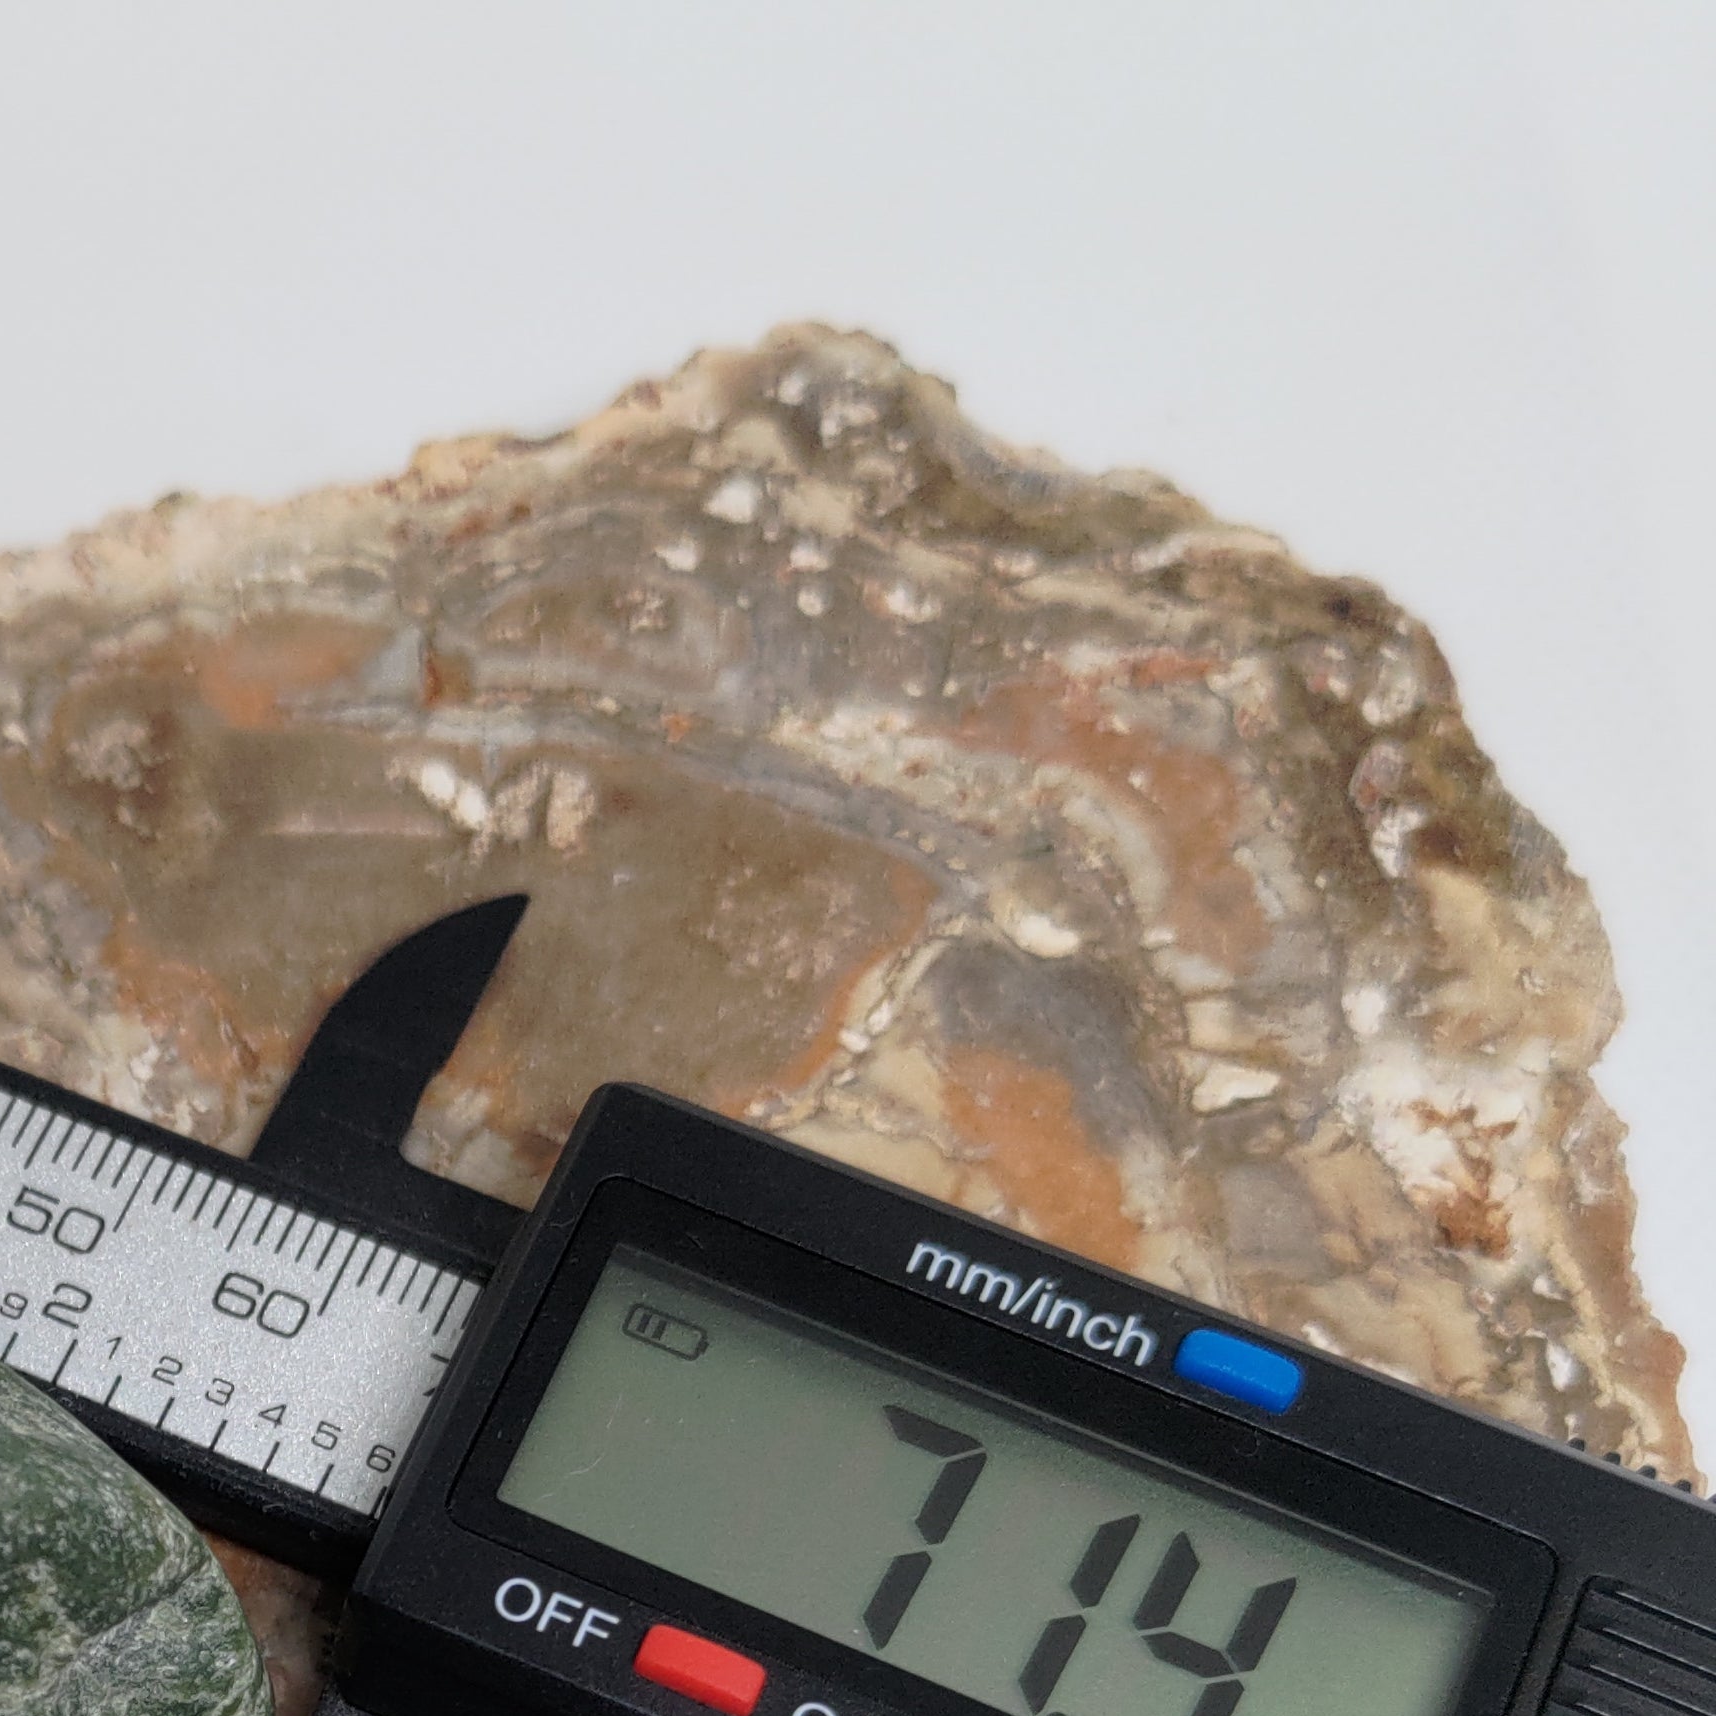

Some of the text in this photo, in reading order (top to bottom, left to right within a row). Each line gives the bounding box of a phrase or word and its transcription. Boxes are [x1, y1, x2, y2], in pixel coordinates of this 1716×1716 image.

[6, 1186, 105, 1255] 50
[212, 1272, 310, 1339] 60
[904, 1236, 1159, 1369] mm/inch
[42, 1282, 93, 1330] 2
[106, 1336, 123, 1361] 1
[151, 1356, 183, 1385] 2
[204, 1377, 235, 1406] 3
[257, 1403, 287, 1429] 4
[310, 1420, 341, 1450] 5
[365, 1444, 397, 1474] 6
[492, 1574, 623, 1652] OFF
